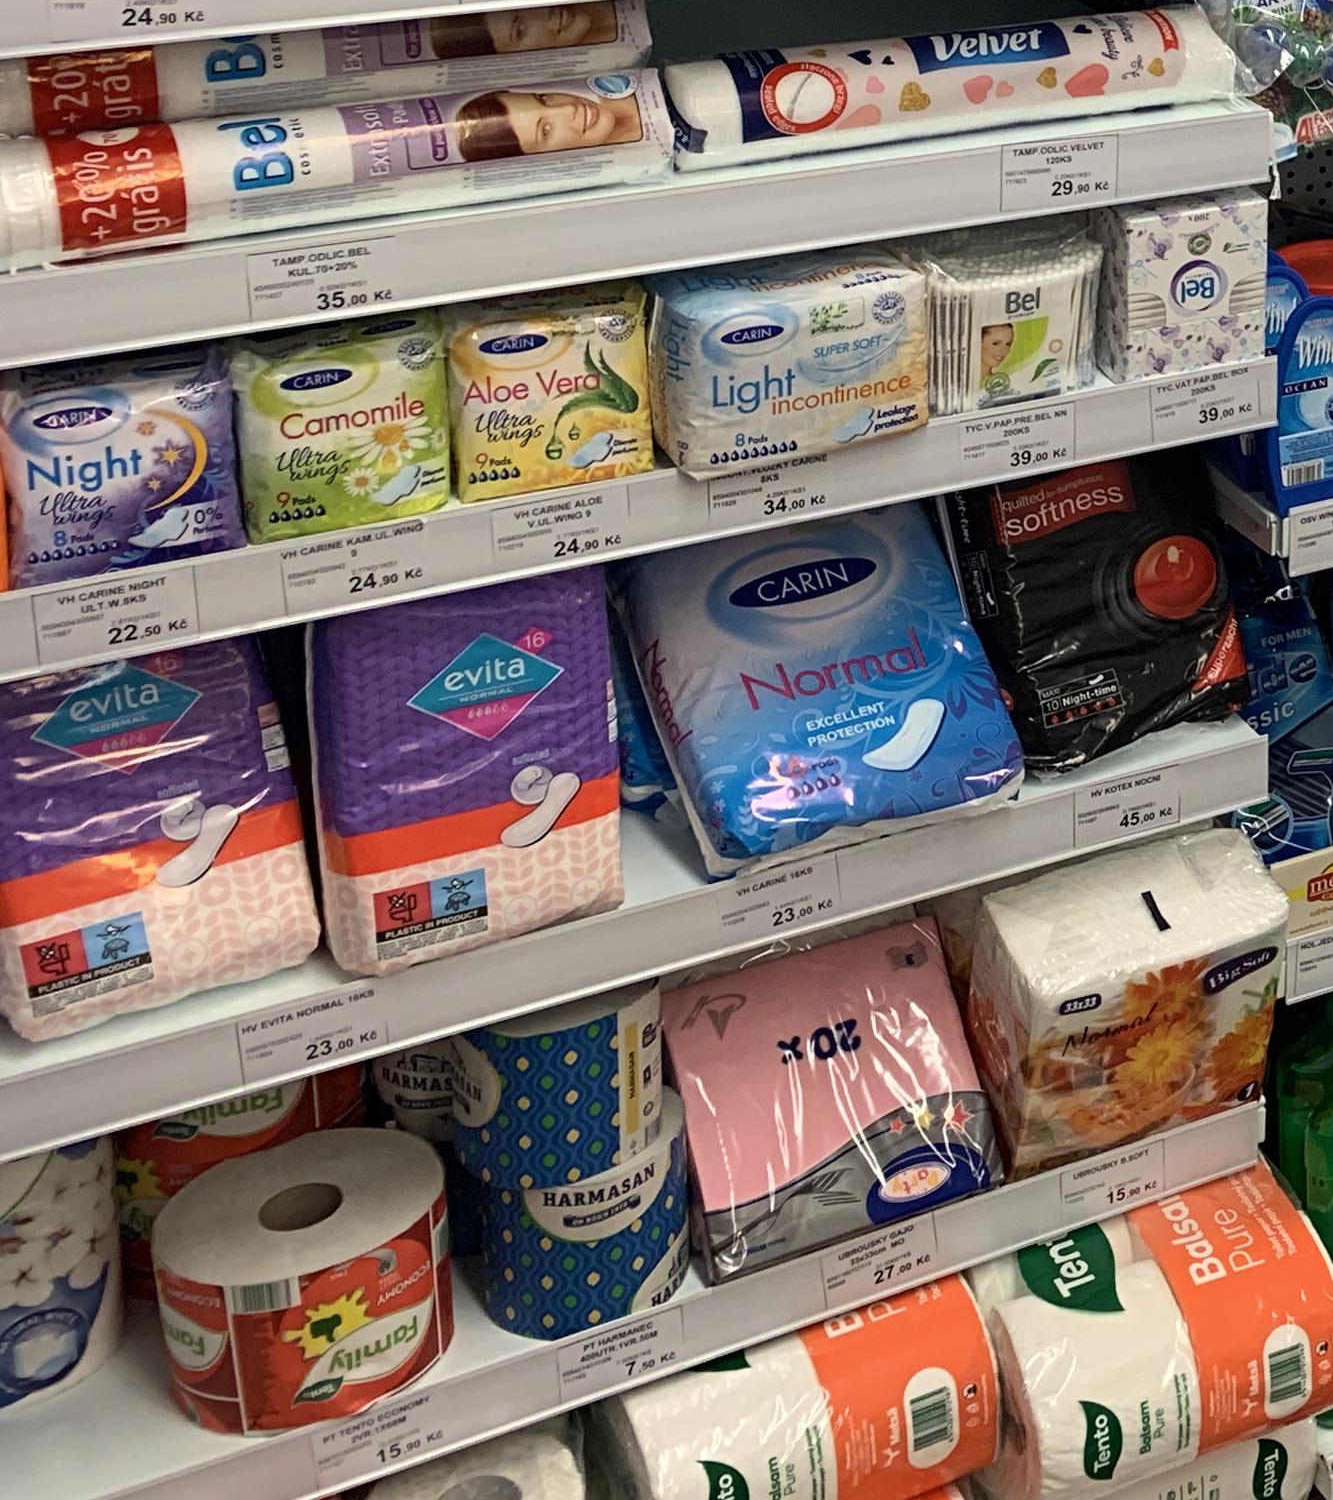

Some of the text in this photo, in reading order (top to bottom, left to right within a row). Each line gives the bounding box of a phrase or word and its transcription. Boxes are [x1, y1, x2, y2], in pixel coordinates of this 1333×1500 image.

[184, 10, 205, 23] Kč
[928, 28, 1042, 60] Velvet
[1005, 292, 1041, 315] Bel
[732, 328, 773, 343] CARIN
[463, 372, 600, 405] Aloe Vera
[712, 366, 796, 412] Light
[772, 376, 911, 416] incontinence
[1285, 378, 1328, 395] OCEAN
[280, 392, 425, 440] Camomile
[27, 452, 143, 495] Night
[1006, 482, 1125, 538] softness
[756, 566, 849, 602] CARIN
[444, 655, 526, 693] evita
[741, 630, 927, 710] Normal
[806, 701, 885, 732] EXCELLENT
[807, 714, 896, 748] PROTECTION
[543, 1163, 655, 1210] HARMASAN
[1095, 1413, 1112, 1474] Tento
[1139, 1398, 1150, 1454] Balsam
